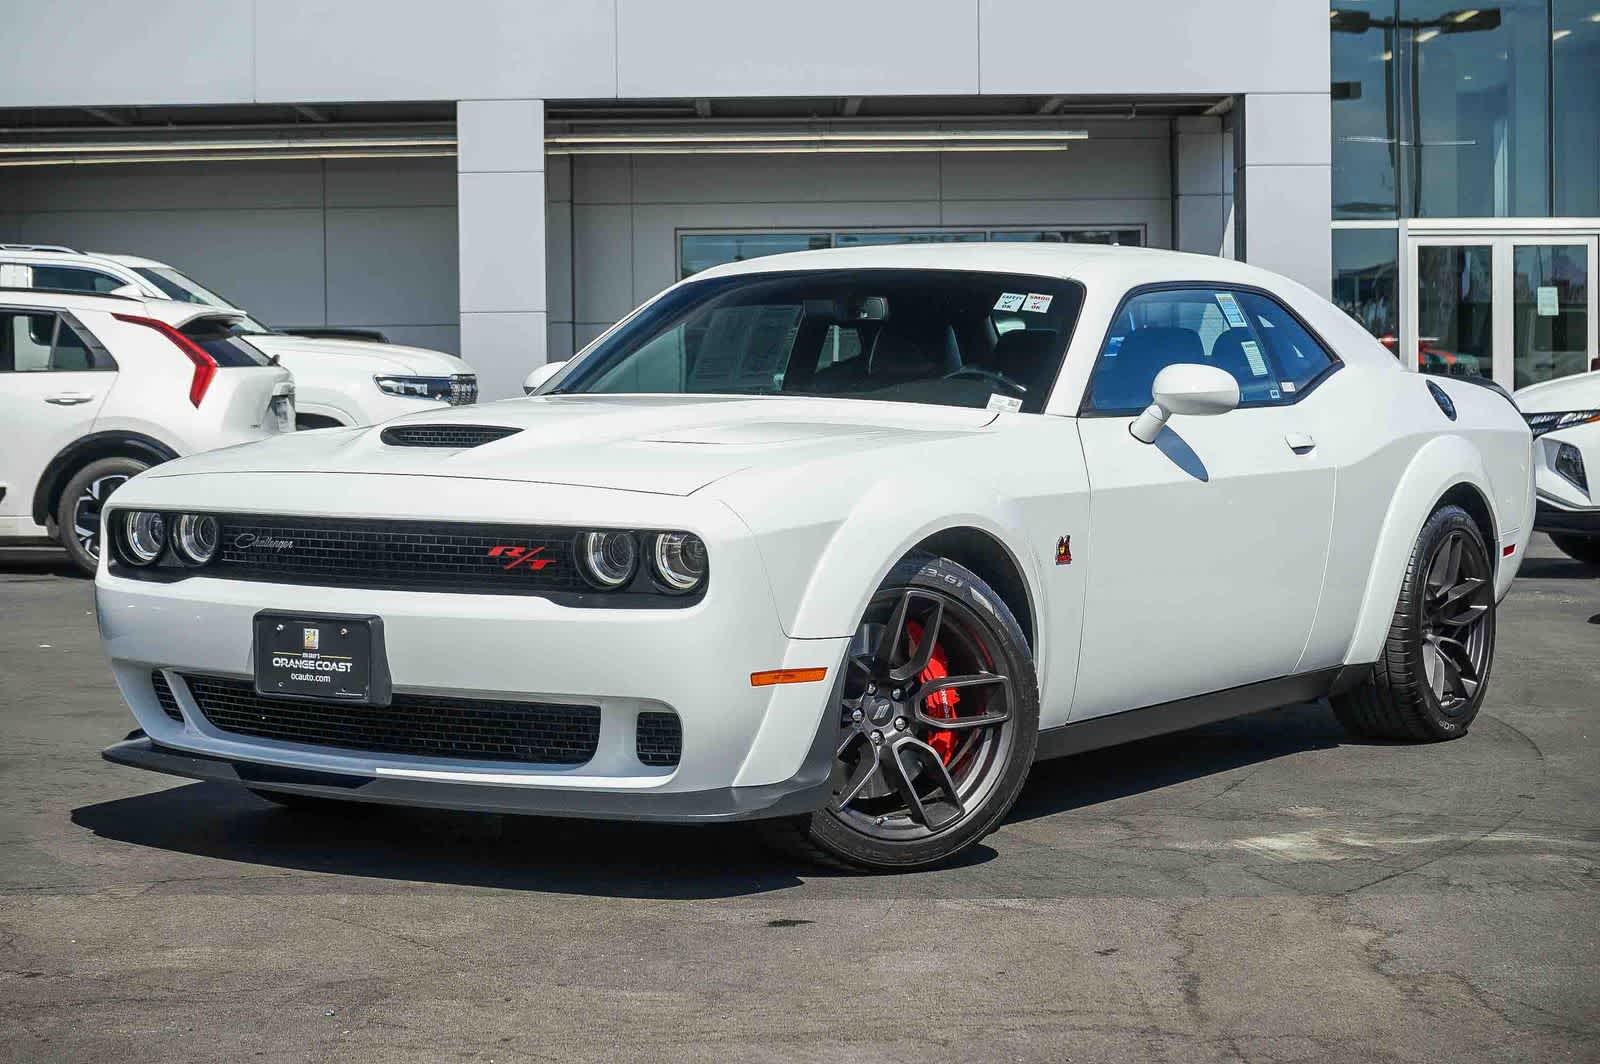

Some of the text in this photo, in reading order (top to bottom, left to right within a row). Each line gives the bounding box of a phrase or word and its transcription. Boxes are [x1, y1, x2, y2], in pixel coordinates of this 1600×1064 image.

[233, 533, 294, 552] Challenger
[488, 546, 557, 570] R/T
[272, 657, 353, 673] ORANGE COAST
[290, 673, 331, 683] ocauto.com
